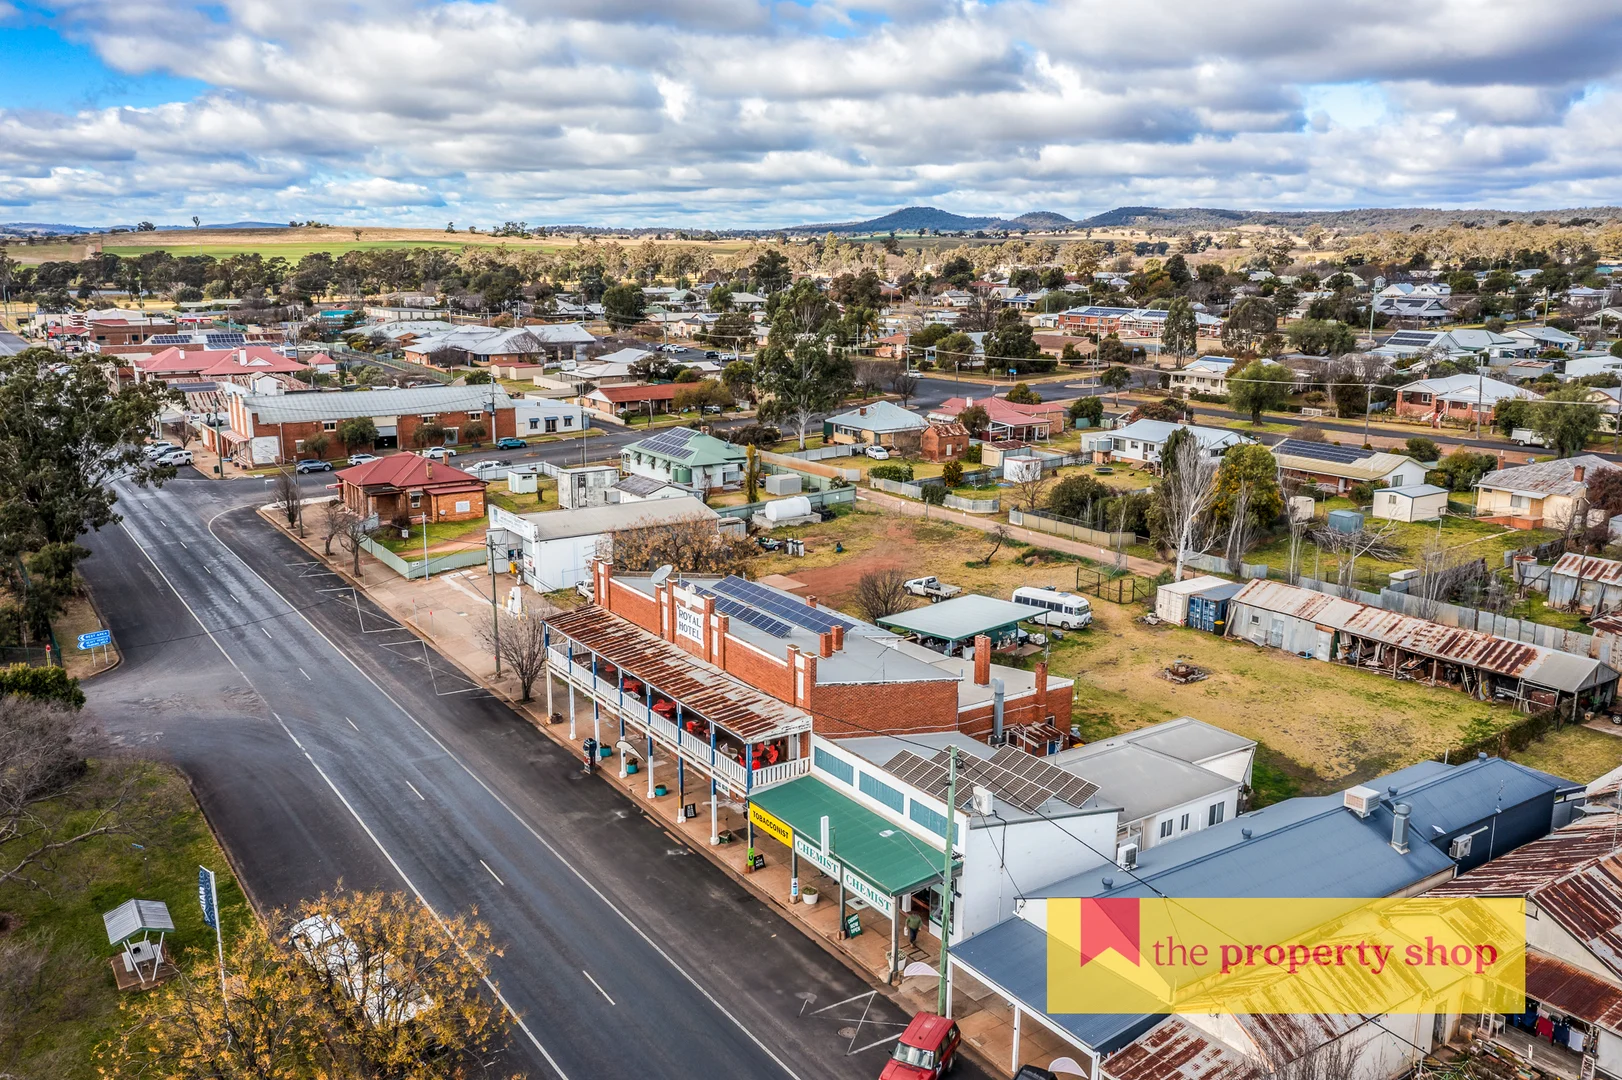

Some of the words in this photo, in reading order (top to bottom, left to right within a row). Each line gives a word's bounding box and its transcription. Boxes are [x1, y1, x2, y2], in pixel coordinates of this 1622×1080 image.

[679, 609, 701, 628] ROYAL
[679, 621, 701, 640] HOTEL
[753, 810, 788, 839] TOBACCONIST
[797, 840, 838, 873] CHEMIST
[846, 874, 891, 911] CHEMIST
